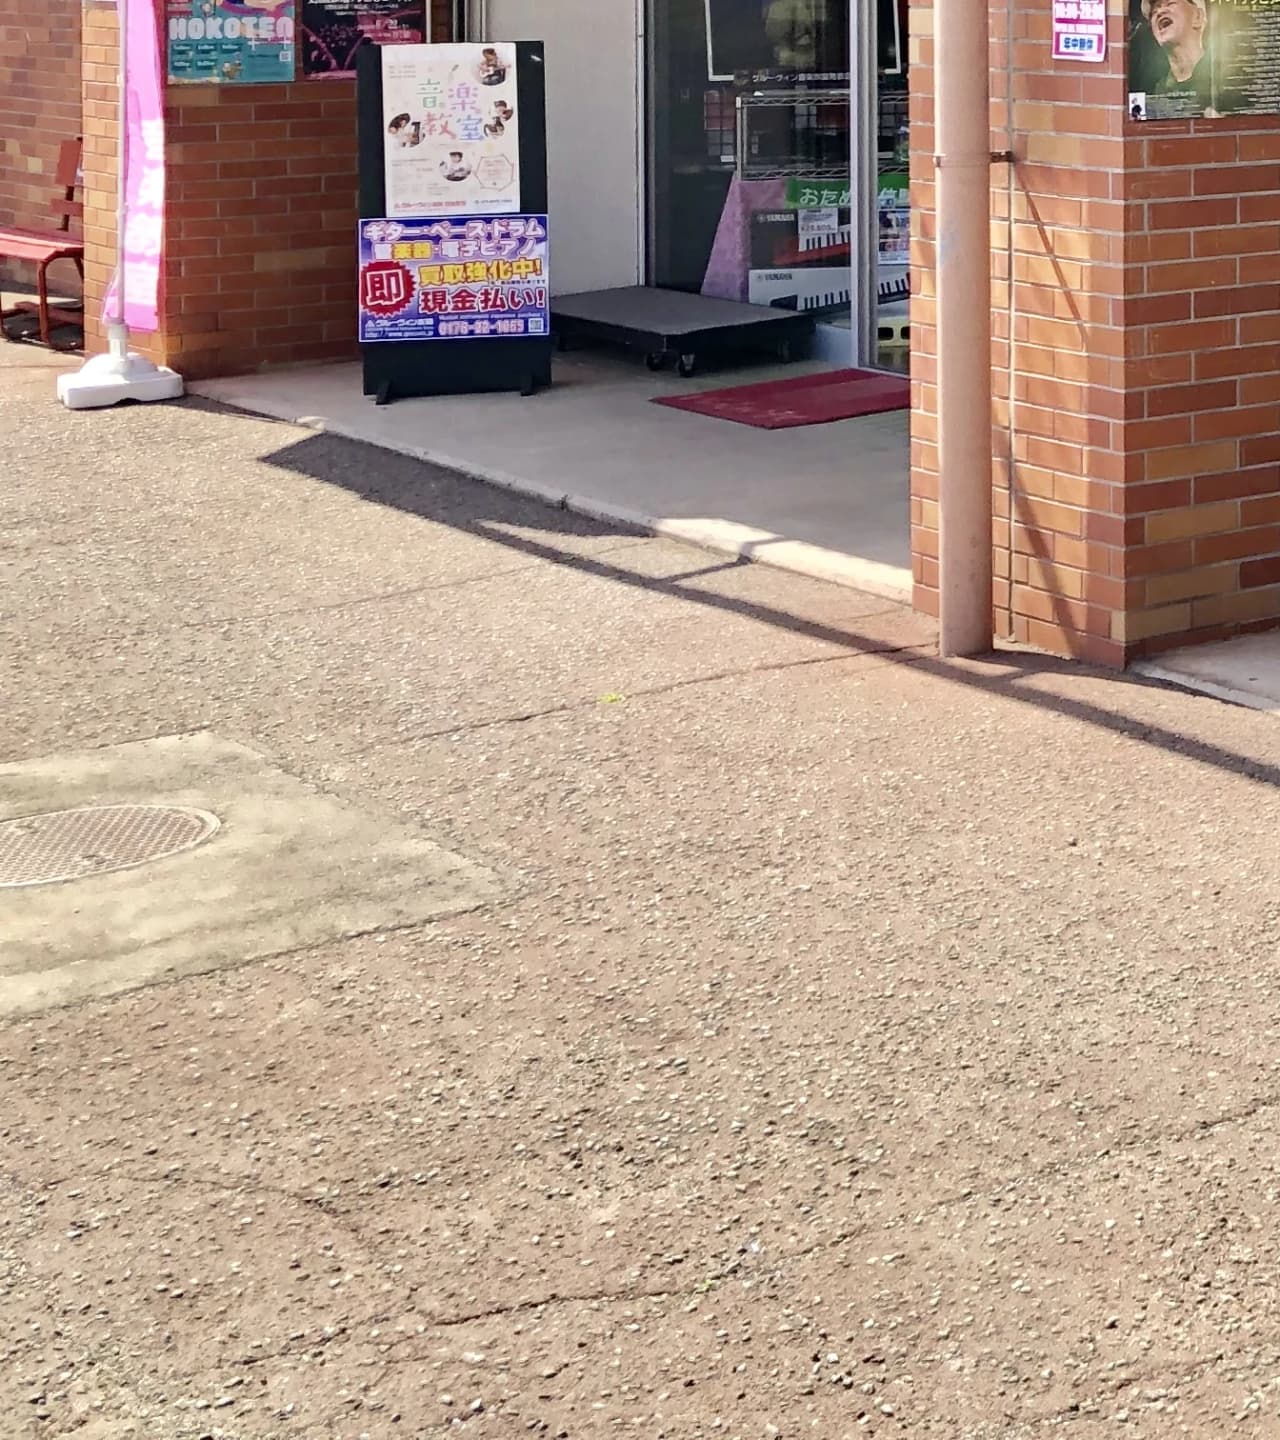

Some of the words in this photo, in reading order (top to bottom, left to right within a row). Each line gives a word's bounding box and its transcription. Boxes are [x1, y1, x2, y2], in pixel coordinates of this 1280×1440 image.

[168, 16, 295, 40] HOKOTEN
[424, 112, 486, 142] 教室
[365, 220, 545, 241] ギター・ベース・ドラム
[418, 257, 543, 287] 買取強化中!
[367, 270, 404, 305] 即
[419, 287, 546, 314] 現金払い!
